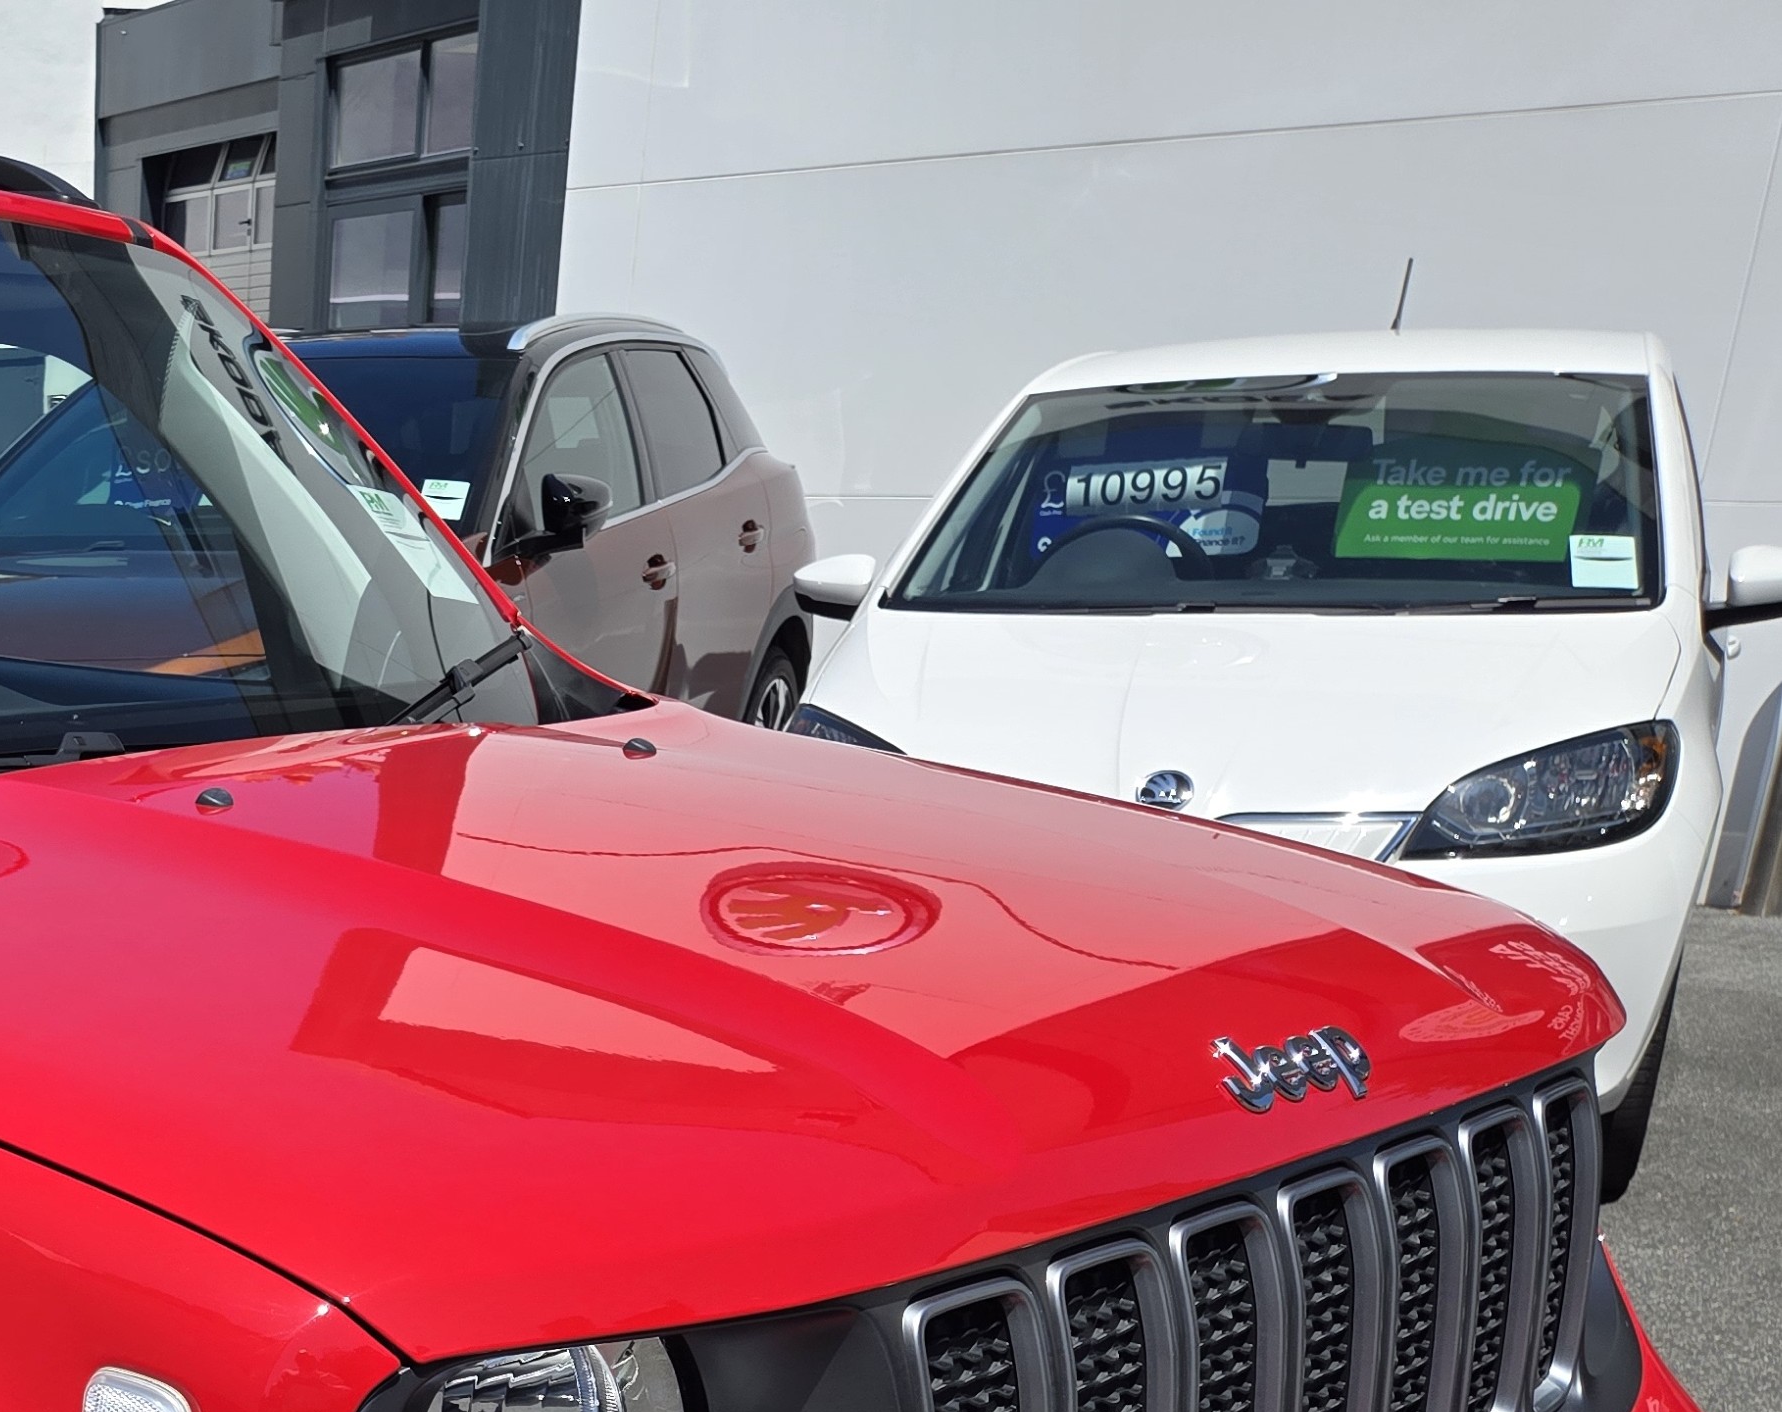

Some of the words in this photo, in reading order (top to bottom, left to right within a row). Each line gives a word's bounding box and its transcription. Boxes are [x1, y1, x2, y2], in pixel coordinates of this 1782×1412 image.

[1372, 458, 1447, 486] Take
[1455, 465, 1509, 487] me
[1519, 459, 1571, 488] for
[1368, 499, 1388, 520] a
[1397, 494, 1464, 521] test
[1472, 494, 1558, 522] drive
[1364, 533, 1381, 543] Ask
[1391, 534, 1429, 544] member
[1430, 534, 1442, 544] of
[1442, 536, 1459, 544] our
[1460, 535, 1485, 545] team
[1486, 535, 1500, 545] for
[1502, 536, 1550, 546] assistance
[1210, 1024, 1372, 1115] Jeep
